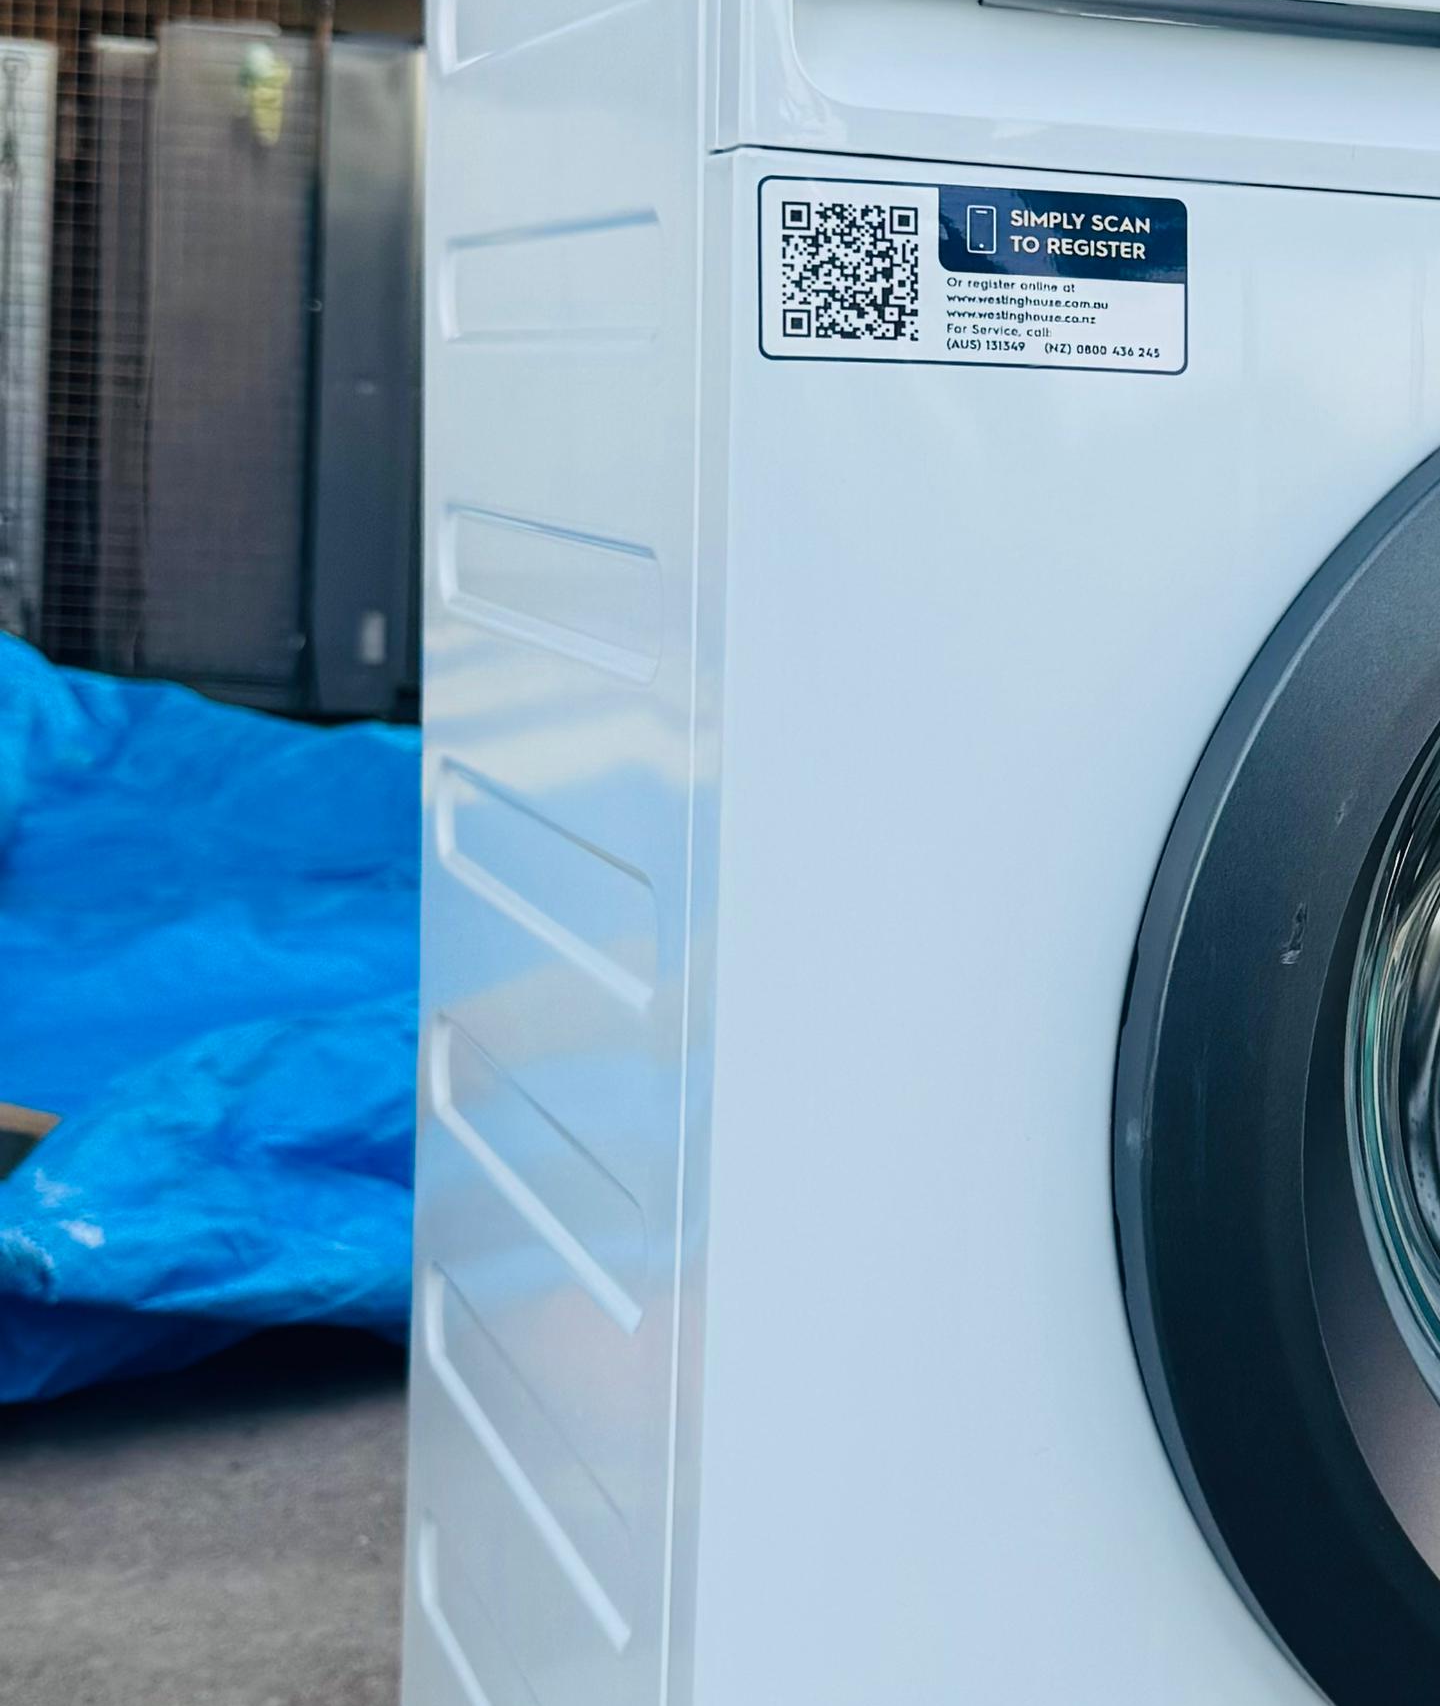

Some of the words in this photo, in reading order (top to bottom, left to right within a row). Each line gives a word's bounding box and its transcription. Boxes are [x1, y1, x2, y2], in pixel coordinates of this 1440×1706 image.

[1010, 209, 1085, 232] SIMPLY
[1090, 213, 1152, 235] SCAN
[1010, 235, 1040, 254] TO
[1046, 237, 1147, 261] REGISTER
[946, 277, 963, 288] Or
[967, 278, 1016, 291] register
[1020, 281, 1059, 293] online
[1062, 283, 1076, 294] at
[946, 293, 1109, 311] www.westinghouse.com.au
[946, 308, 1097, 326] www.westinghouse.co.nz
[946, 323, 968, 335] For
[972, 324, 1022, 338] Service,
[1026, 326, 1052, 338] call:
[946, 339, 982, 352] (AUS)
[985, 340, 1026, 353] 131349
[1044, 342, 1072, 355] (NZ)
[1076, 344, 1107, 356] 0800
[1112, 345, 1134, 357] 436
[1138, 346, 1161, 359] 245
